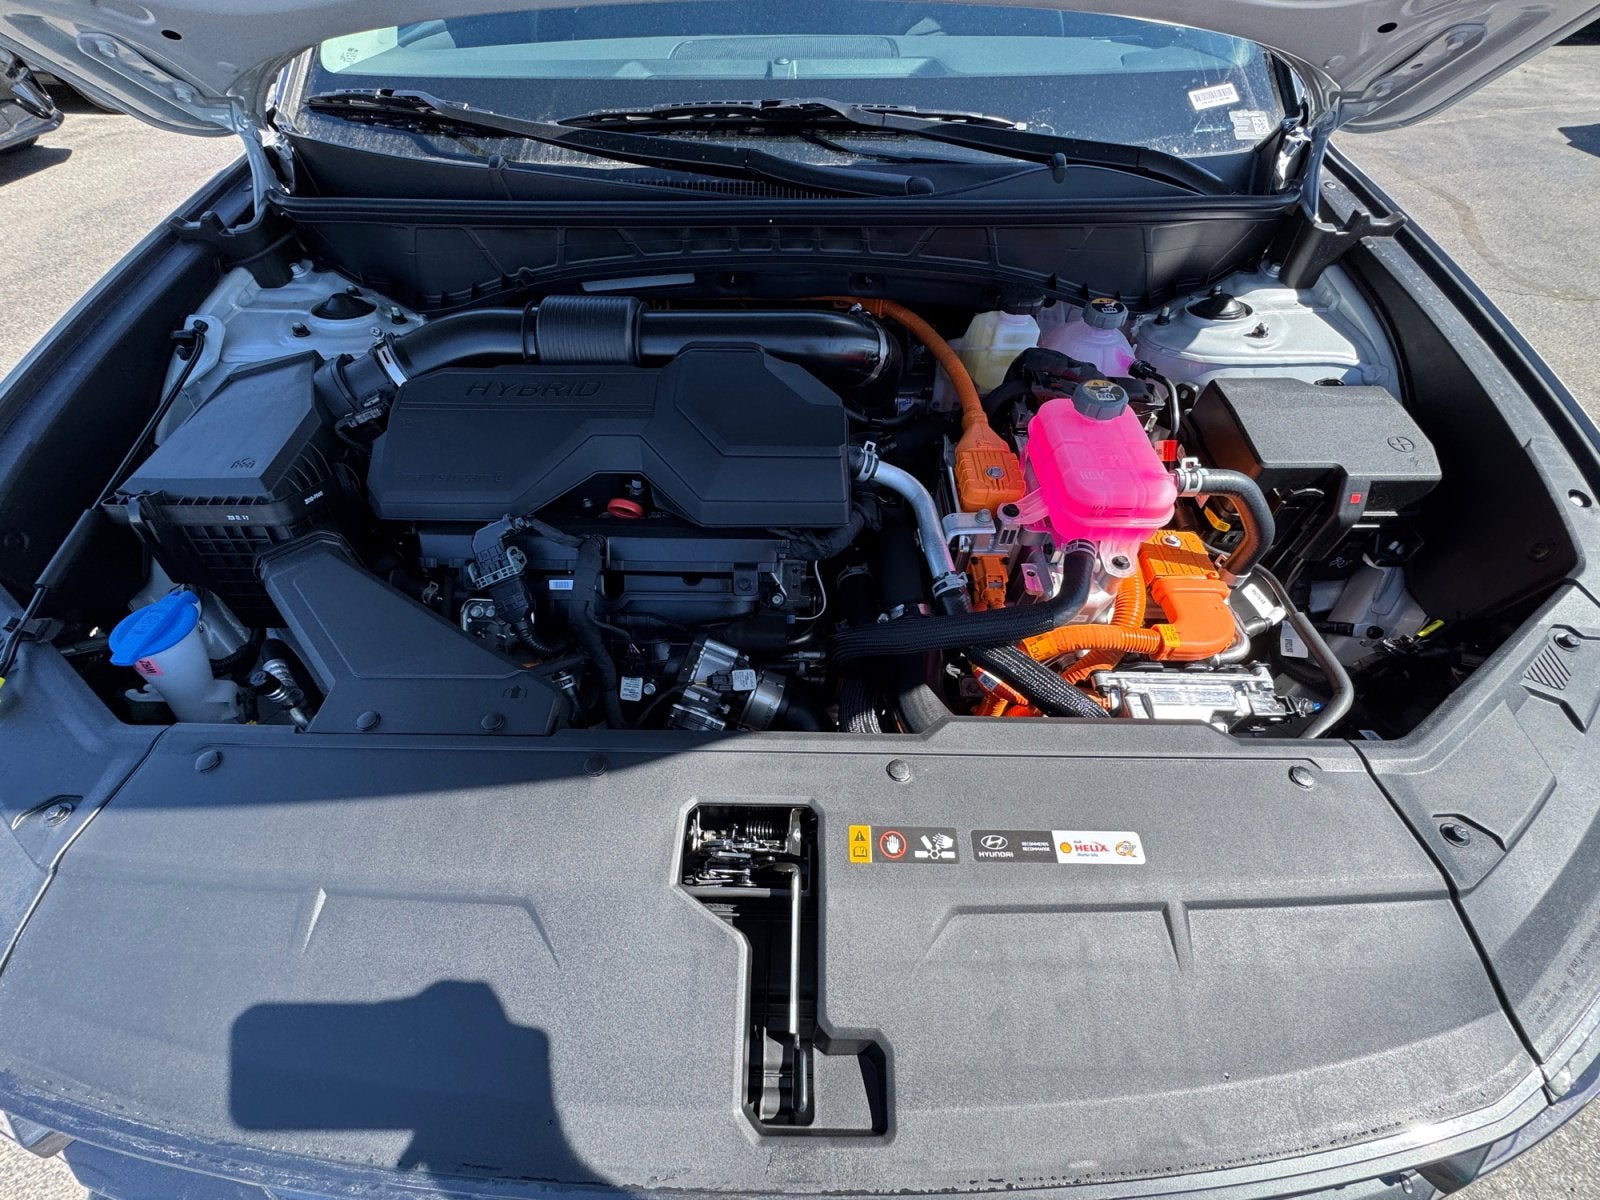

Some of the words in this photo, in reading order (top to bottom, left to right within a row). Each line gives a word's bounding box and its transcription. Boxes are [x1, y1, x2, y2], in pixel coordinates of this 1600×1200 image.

[464, 381, 604, 398] HYBRID
[1074, 843, 1109, 852] HELIX
[978, 850, 1014, 858] HYUNDAI
